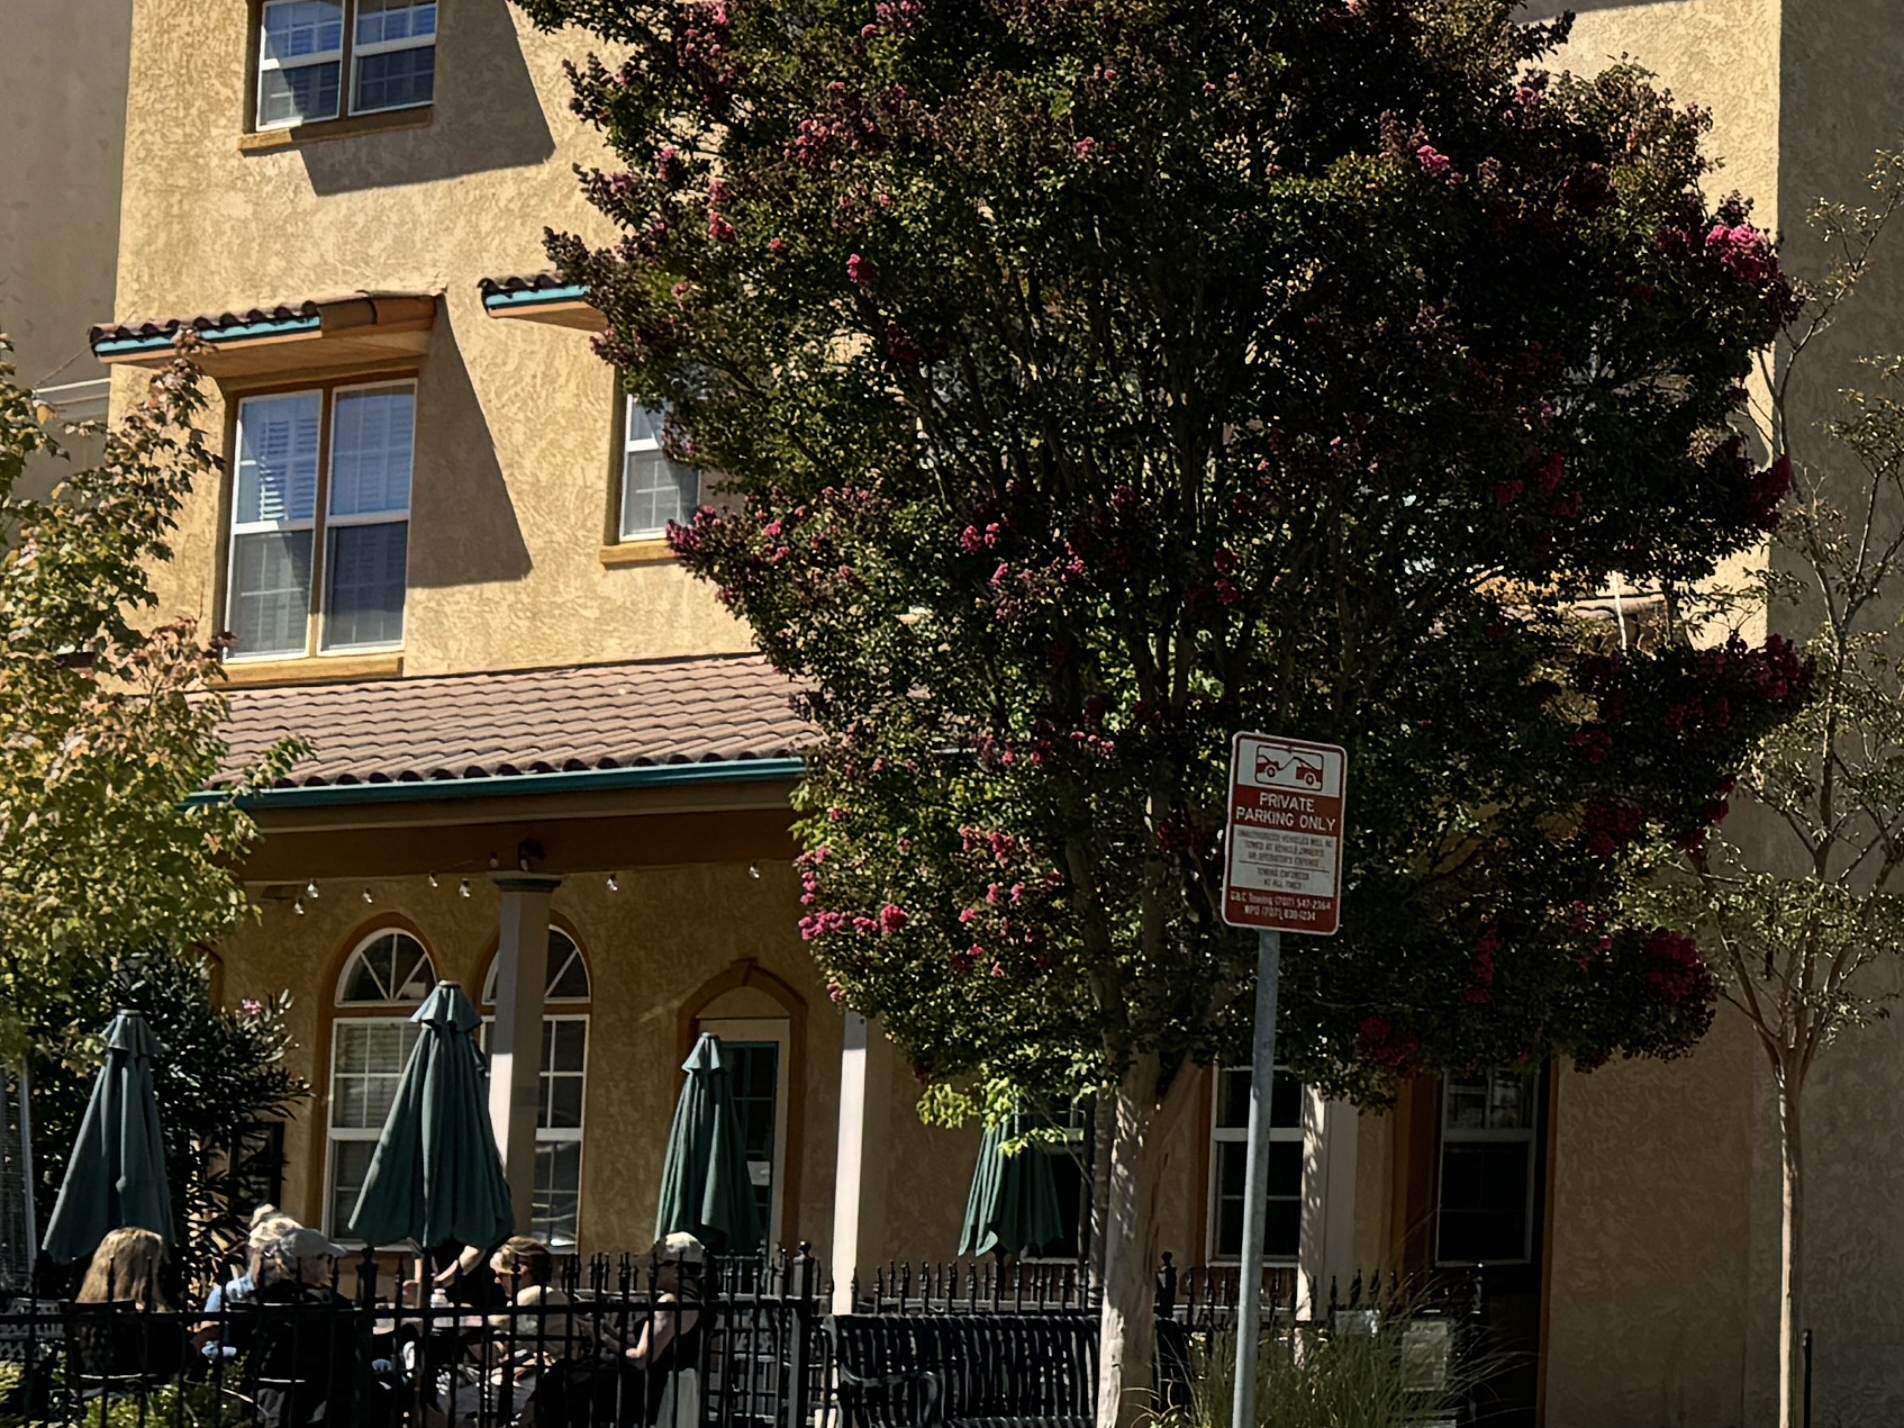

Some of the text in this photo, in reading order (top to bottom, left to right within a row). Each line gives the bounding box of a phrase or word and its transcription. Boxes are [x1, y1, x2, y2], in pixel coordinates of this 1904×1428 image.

[1259, 791, 1315, 813] PRIVATE
[1235, 806, 1337, 832] PARKING ONLY
